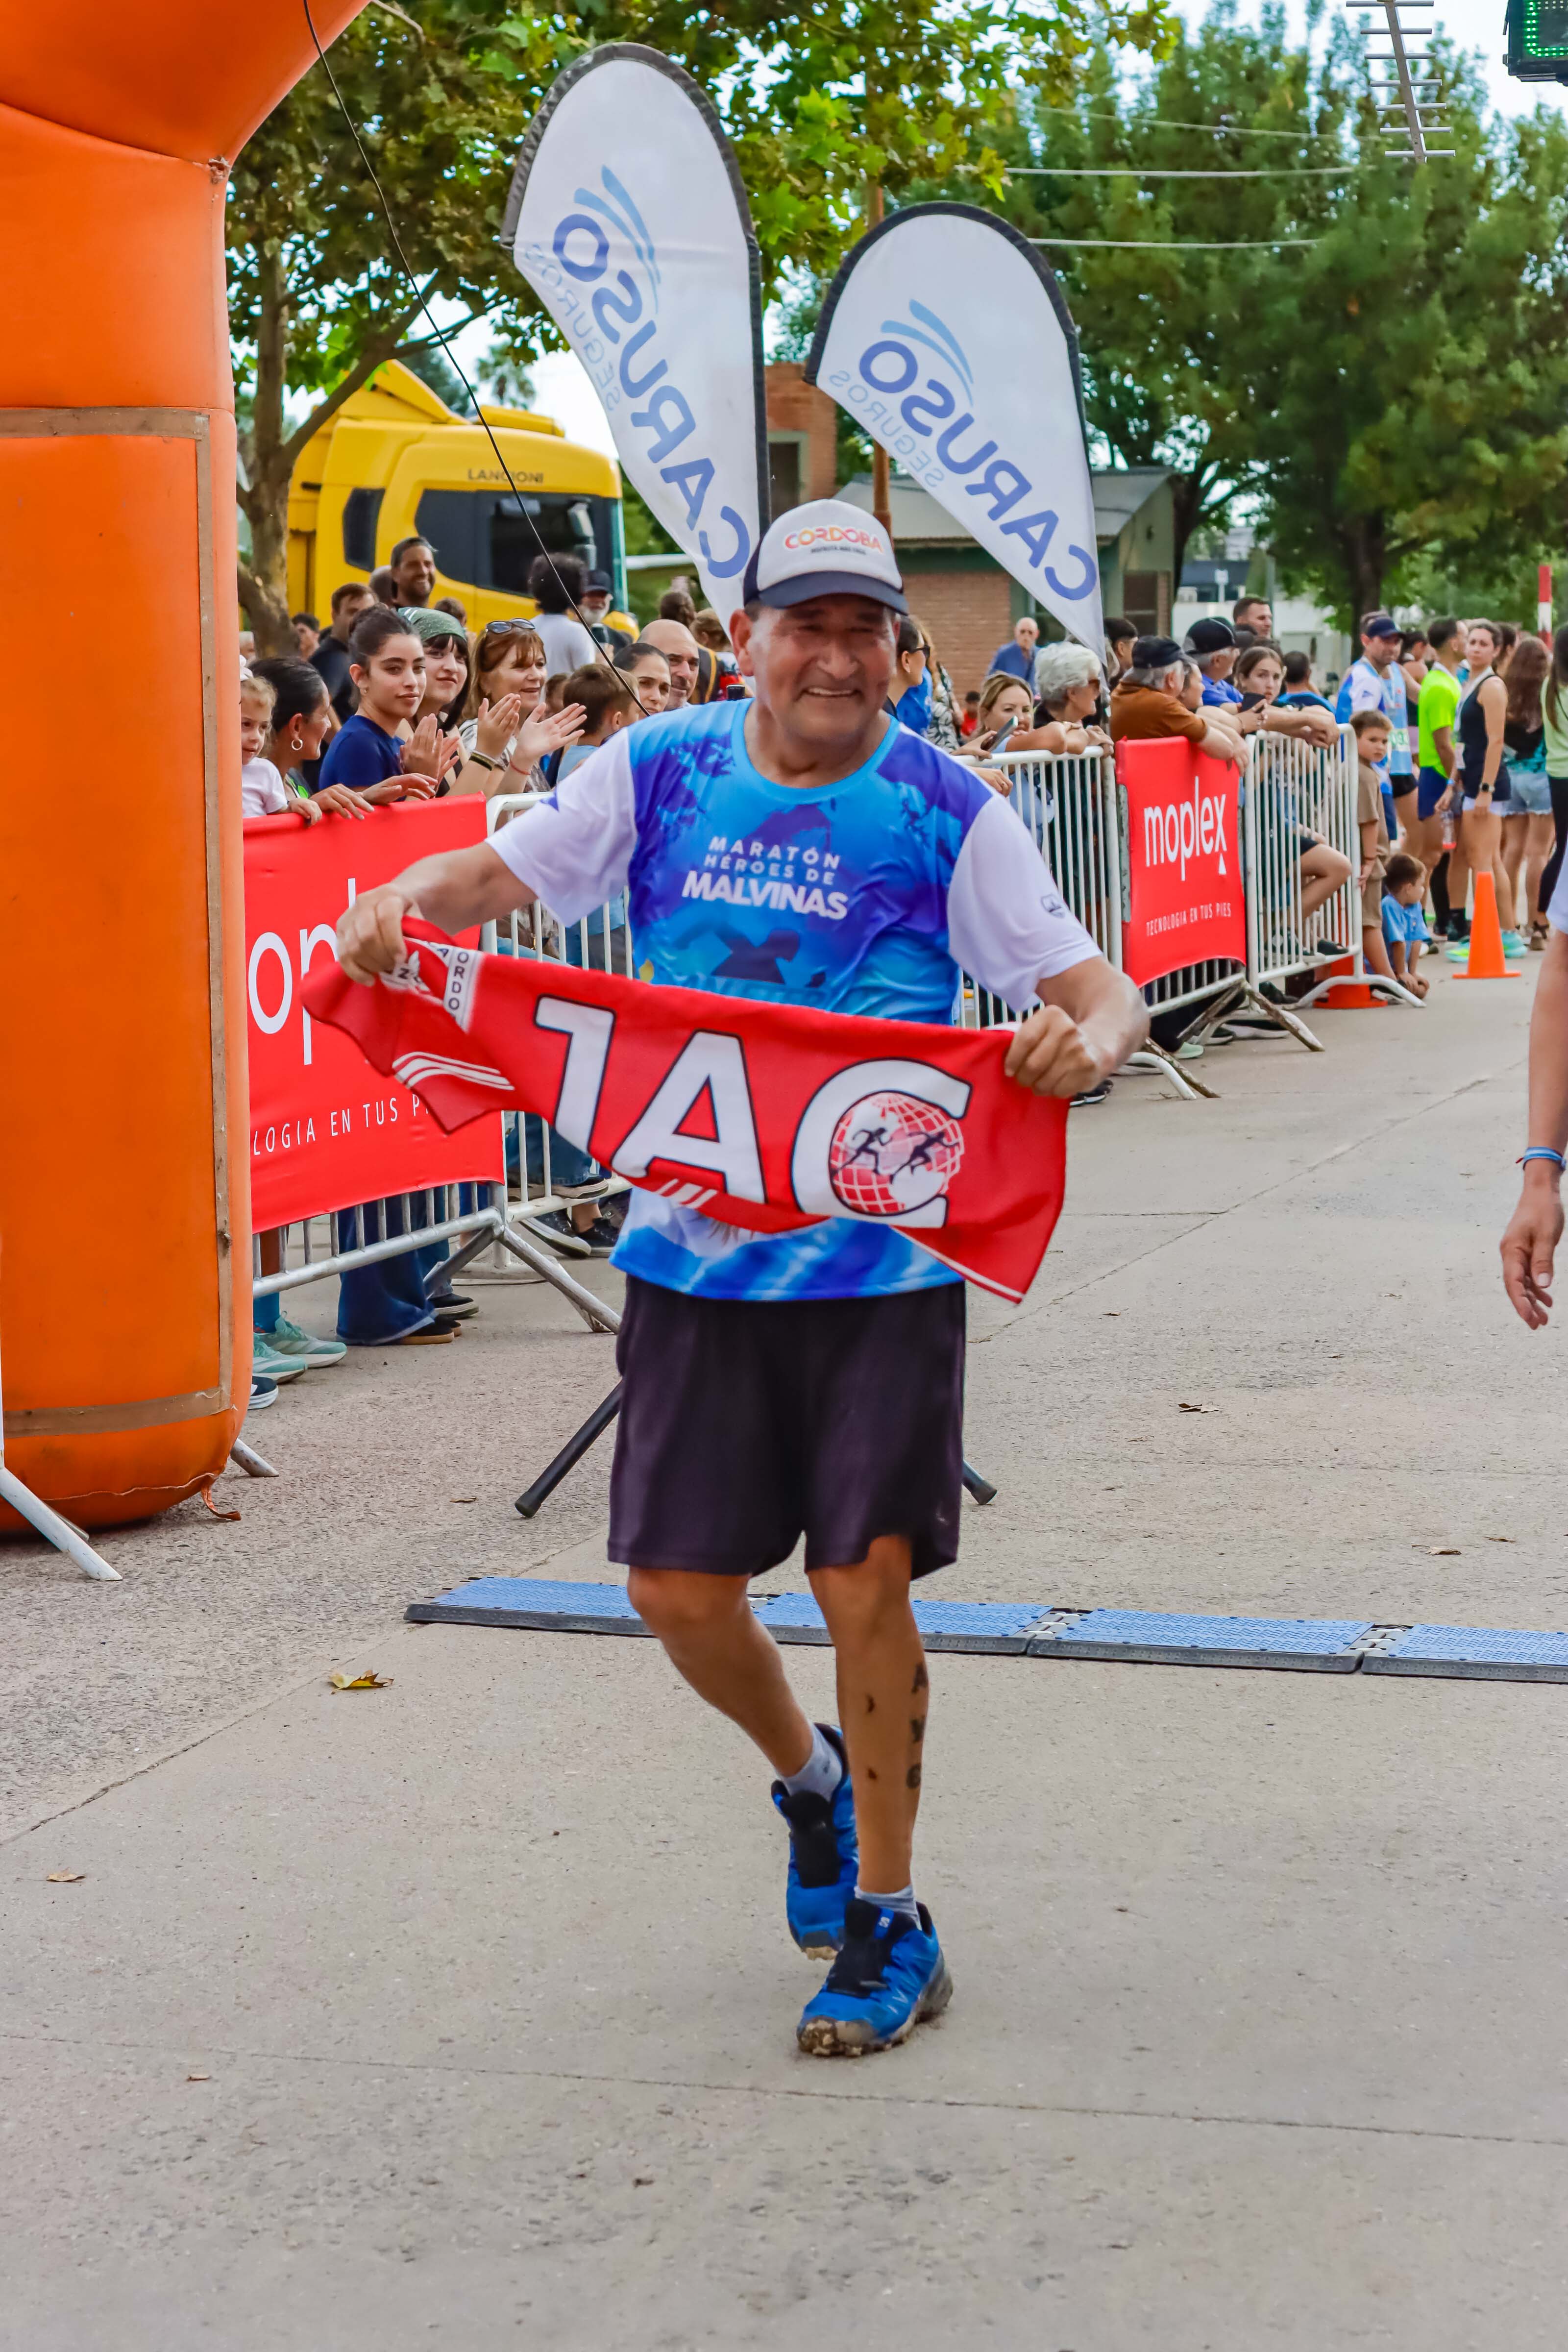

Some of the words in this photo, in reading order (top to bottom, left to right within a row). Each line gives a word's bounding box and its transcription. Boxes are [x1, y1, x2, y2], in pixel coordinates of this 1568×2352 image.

[1144, 776, 1227, 881] moplex
[704, 853, 795, 878] HÉROES
[806, 868, 835, 885] DE
[708, 836, 840, 869] MARATÓN
[682, 870, 849, 920] MALVINAS
[1190, 907, 1198, 923] EN
[1200, 903, 1213, 919] TUS
[1216, 902, 1231, 917] PIES
[253, 1117, 316, 1156] LOGIA
[330, 1108, 351, 1137] EN
[363, 1097, 398, 1128] TUS
